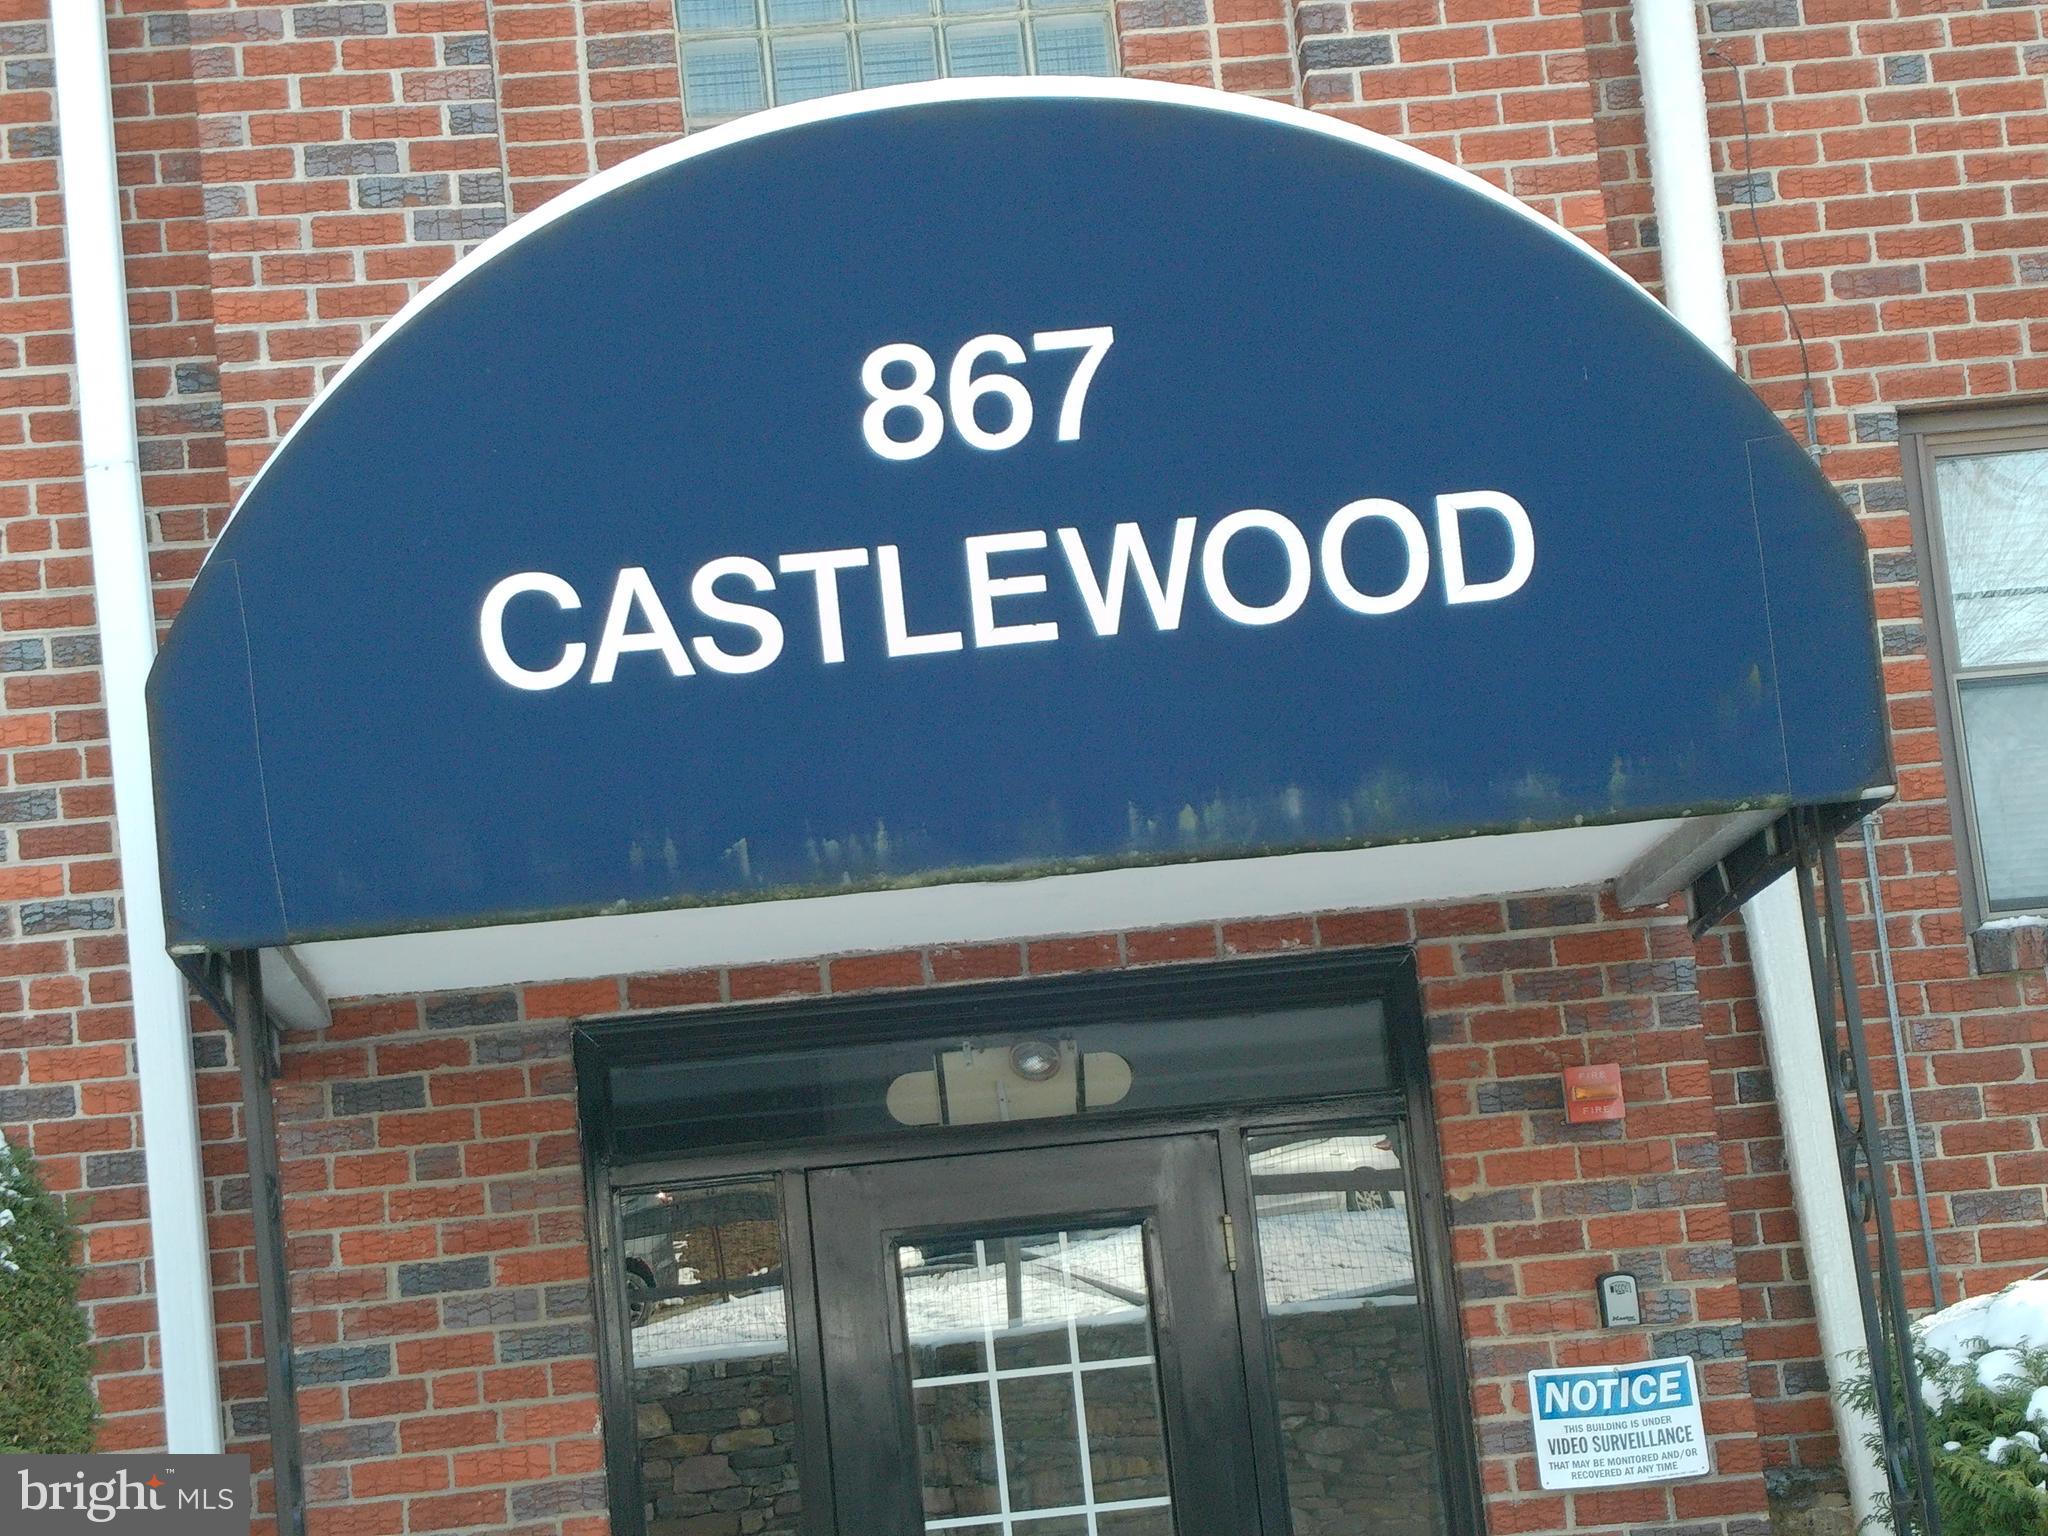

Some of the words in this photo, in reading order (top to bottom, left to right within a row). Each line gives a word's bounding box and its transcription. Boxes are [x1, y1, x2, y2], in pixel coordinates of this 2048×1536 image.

[861, 326, 1114, 461] 867
[479, 490, 1536, 691] CASTLEWOOD
[1578, 1071, 1606, 1080] FIRE
[1582, 1105, 1610, 1114] FIRE
[1545, 1370, 1682, 1413] NOTICE
[1564, 1424, 1583, 1434] THIS
[1586, 1420, 1628, 1432] BUILDING
[1630, 1419, 1640, 1429] IS
[1642, 1415, 1672, 1427] UNDER
[1547, 1436, 1588, 1456] VIDEO
[1593, 1425, 1694, 1453] SURVEILLANCE
[1549, 1461, 1570, 1471] THAT
[1572, 1459, 1591, 1469] MAY
[1593, 1458, 1605, 1468] BE
[1607, 1452, 1659, 1467] MONITORED
[1661, 1447, 1698, 1461] AND/OR
[1571, 1468, 1622, 1481] RECOVERED
[1624, 1466, 1636, 1476] AT
[1637, 1464, 1654, 1474] ANY
[1656, 1461, 1678, 1472] TIME
